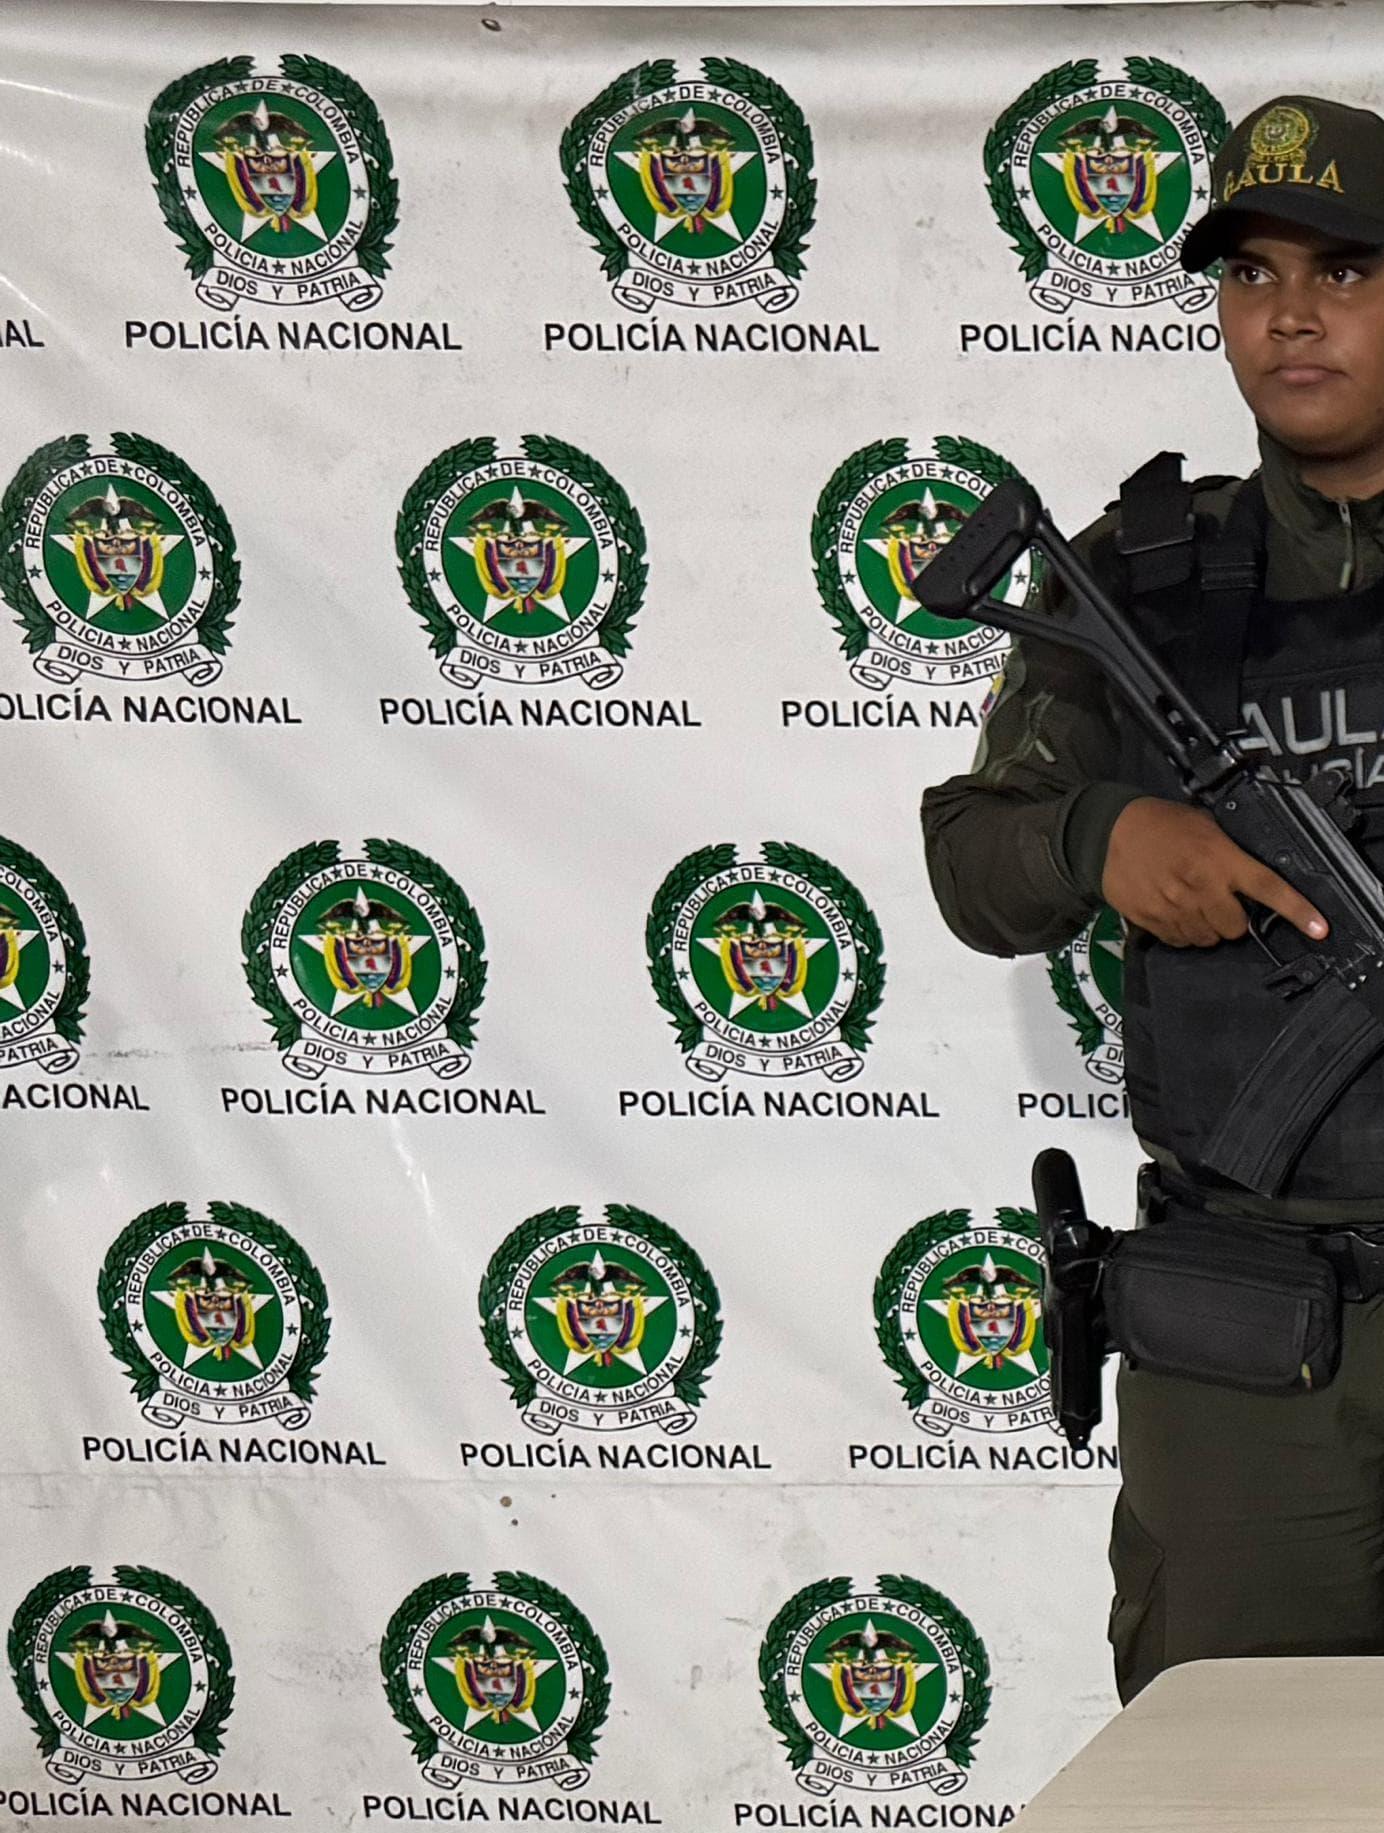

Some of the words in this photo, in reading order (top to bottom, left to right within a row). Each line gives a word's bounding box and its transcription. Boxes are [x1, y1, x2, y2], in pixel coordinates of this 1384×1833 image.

[252, 80, 280, 91] DE
[295, 87, 360, 163] COLOMBIA
[204, 223, 268, 273] POLICIA
[291, 221, 363, 275] NACIONAL
[217, 270, 258, 295] DIOS
[272, 285, 283, 299] Y
[298, 271, 361, 298] PATRIA
[126, 314, 269, 349] POLICÍA
[278, 322, 462, 350] NACIONAL
[545, 316, 686, 351] POLICÍA
[696, 324, 879, 352] NACIONAL
[961, 317, 1101, 352] POLICÍA
[1112, 324, 1221, 351] NACIO
[0, 688, 112, 721] OLICÍA
[124, 696, 302, 723] NACIONAL
[380, 692, 512, 725] POLICÍA
[521, 700, 701, 726] NACIONAL
[782, 694, 920, 727] POLICÍA
[3, 1084, 149, 1110] ACIONAL
[221, 1082, 355, 1114] POLICÍA
[367, 1089, 545, 1114] NACIONAL
[620, 1085, 754, 1116] POLICÍA
[764, 1092, 939, 1117] NACIONAL
[1018, 1088, 1129, 1118] POLICÍ
[583, 1228, 607, 1241] DE
[624, 1236, 689, 1307] COLOMBIA
[528, 1359, 590, 1402] POLICIA
[613, 1355, 684, 1403] NACIONAL
[540, 1400, 579, 1422] DIOS
[594, 1413, 604, 1426] Y
[619, 1401, 676, 1425] PATRIA
[83, 1431, 212, 1462] POLICÍA
[220, 1438, 386, 1465] NACIONAL
[461, 1438, 591, 1467] POLICÍA
[598, 1444, 771, 1468] NACIONAL
[849, 1439, 980, 1469] POLICÍA
[989, 1446, 1117, 1470] NACION
[121, 1793, 291, 1816] NACIONAL
[363, 1792, 489, 1821] POLICÍA
[499, 1798, 662, 1824] NACIONAL
[735, 1799, 861, 1827] POLICÍA
[871, 1804, 1025, 1827] NACIONA
